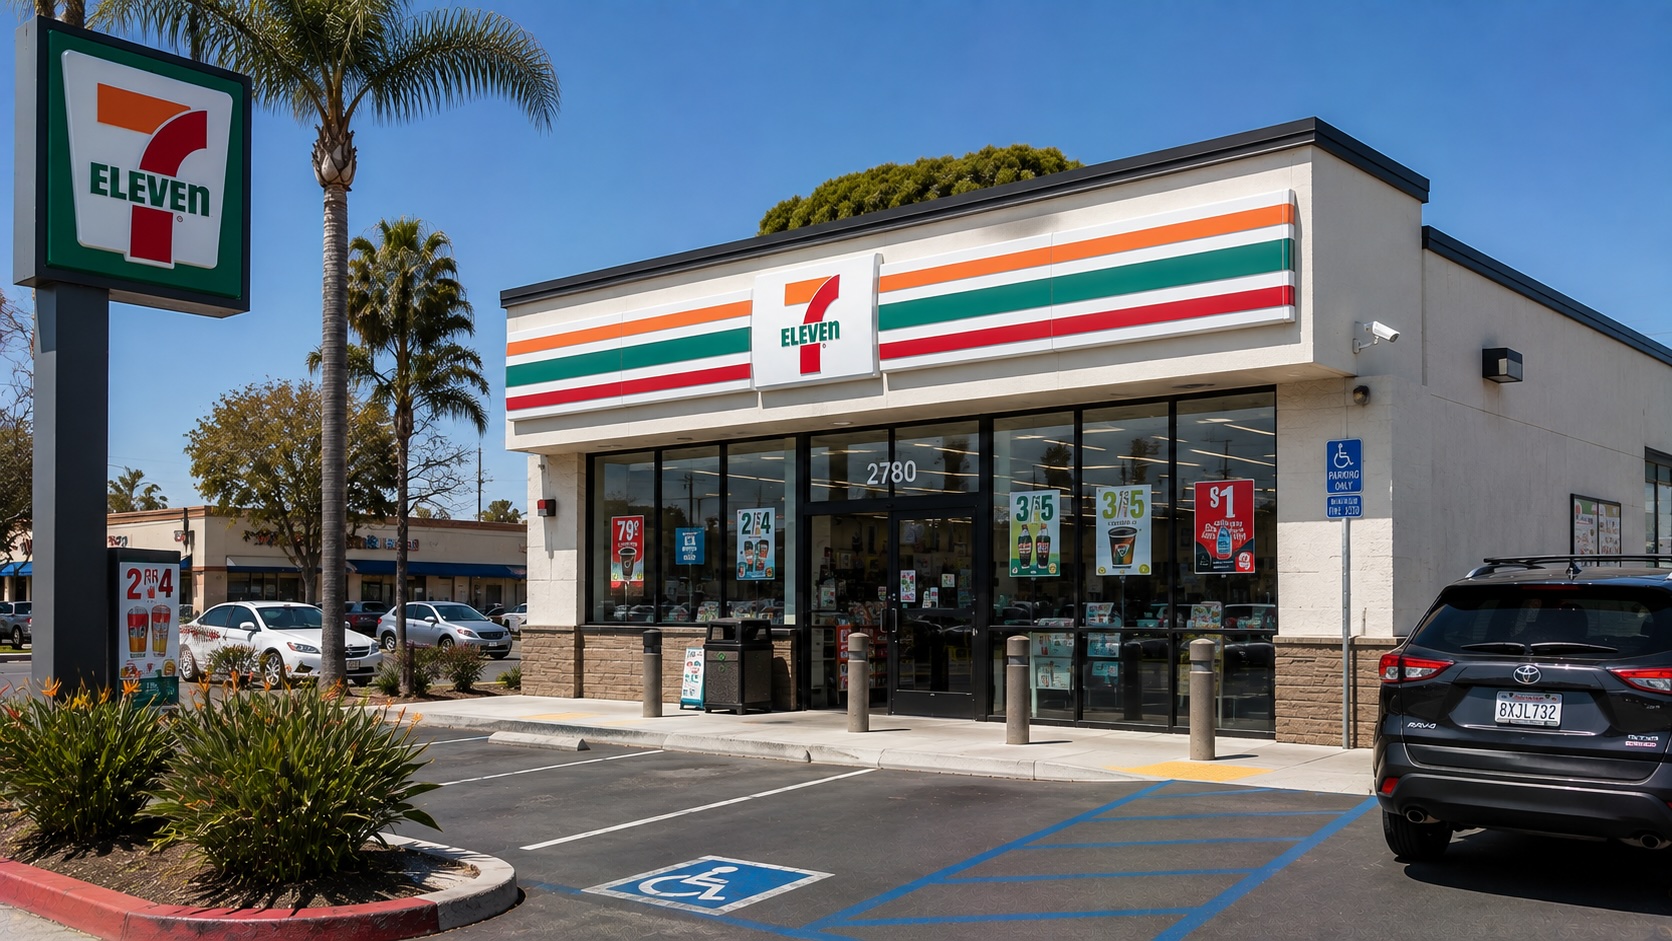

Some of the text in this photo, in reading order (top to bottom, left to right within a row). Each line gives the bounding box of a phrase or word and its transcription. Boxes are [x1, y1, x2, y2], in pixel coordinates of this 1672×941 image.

[97, 83, 207, 264] 7
[784, 274, 840, 374] 7
[867, 460, 916, 485] 2780
[1499, 702, 1557, 720] 8XJL732
